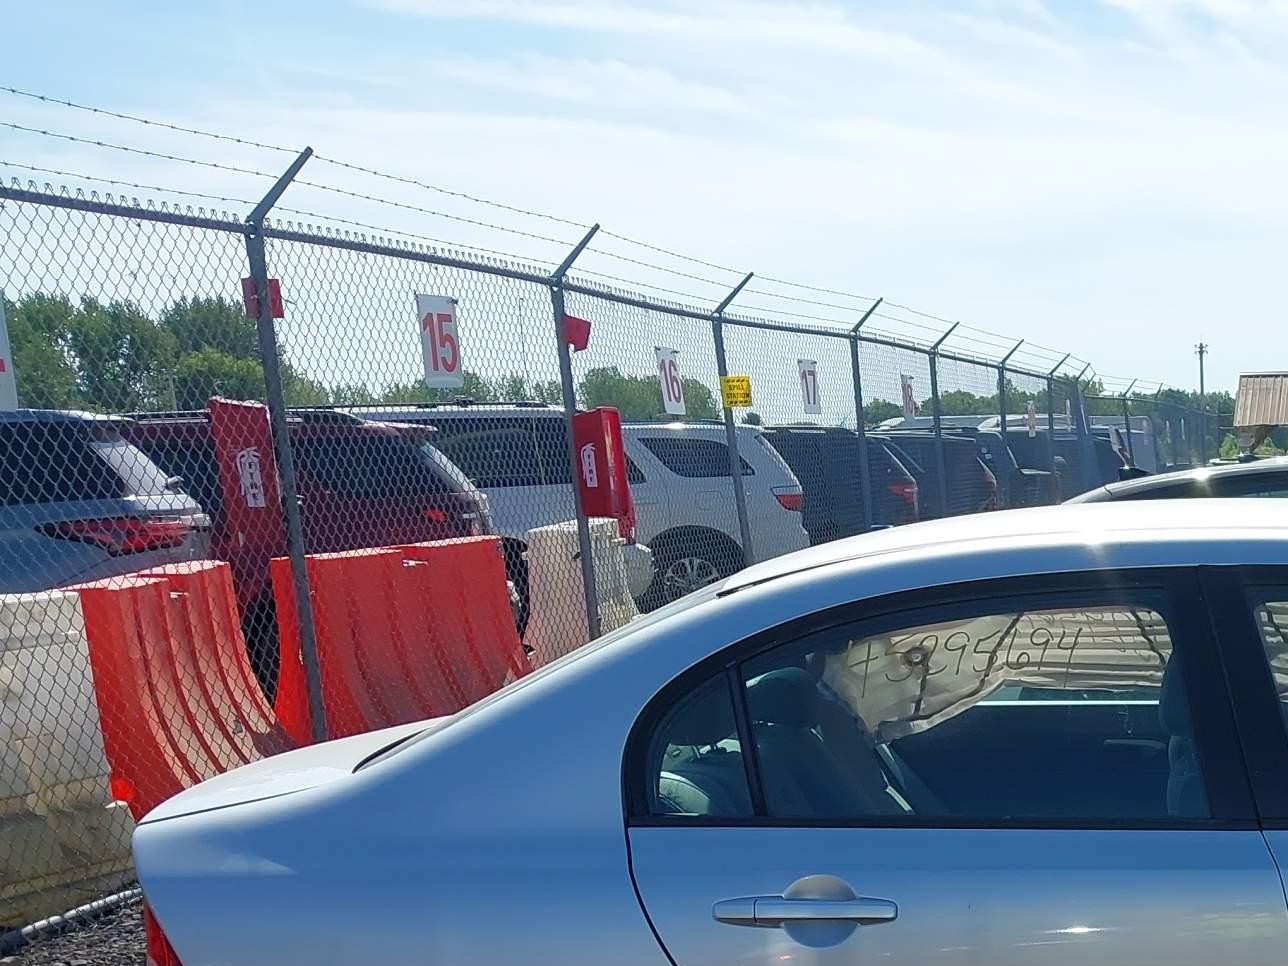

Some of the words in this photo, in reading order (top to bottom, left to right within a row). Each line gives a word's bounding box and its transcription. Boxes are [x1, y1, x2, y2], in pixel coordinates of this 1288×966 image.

[422, 312, 457, 373] 15
[660, 358, 682, 403] 16
[801, 369, 816, 405] 17
